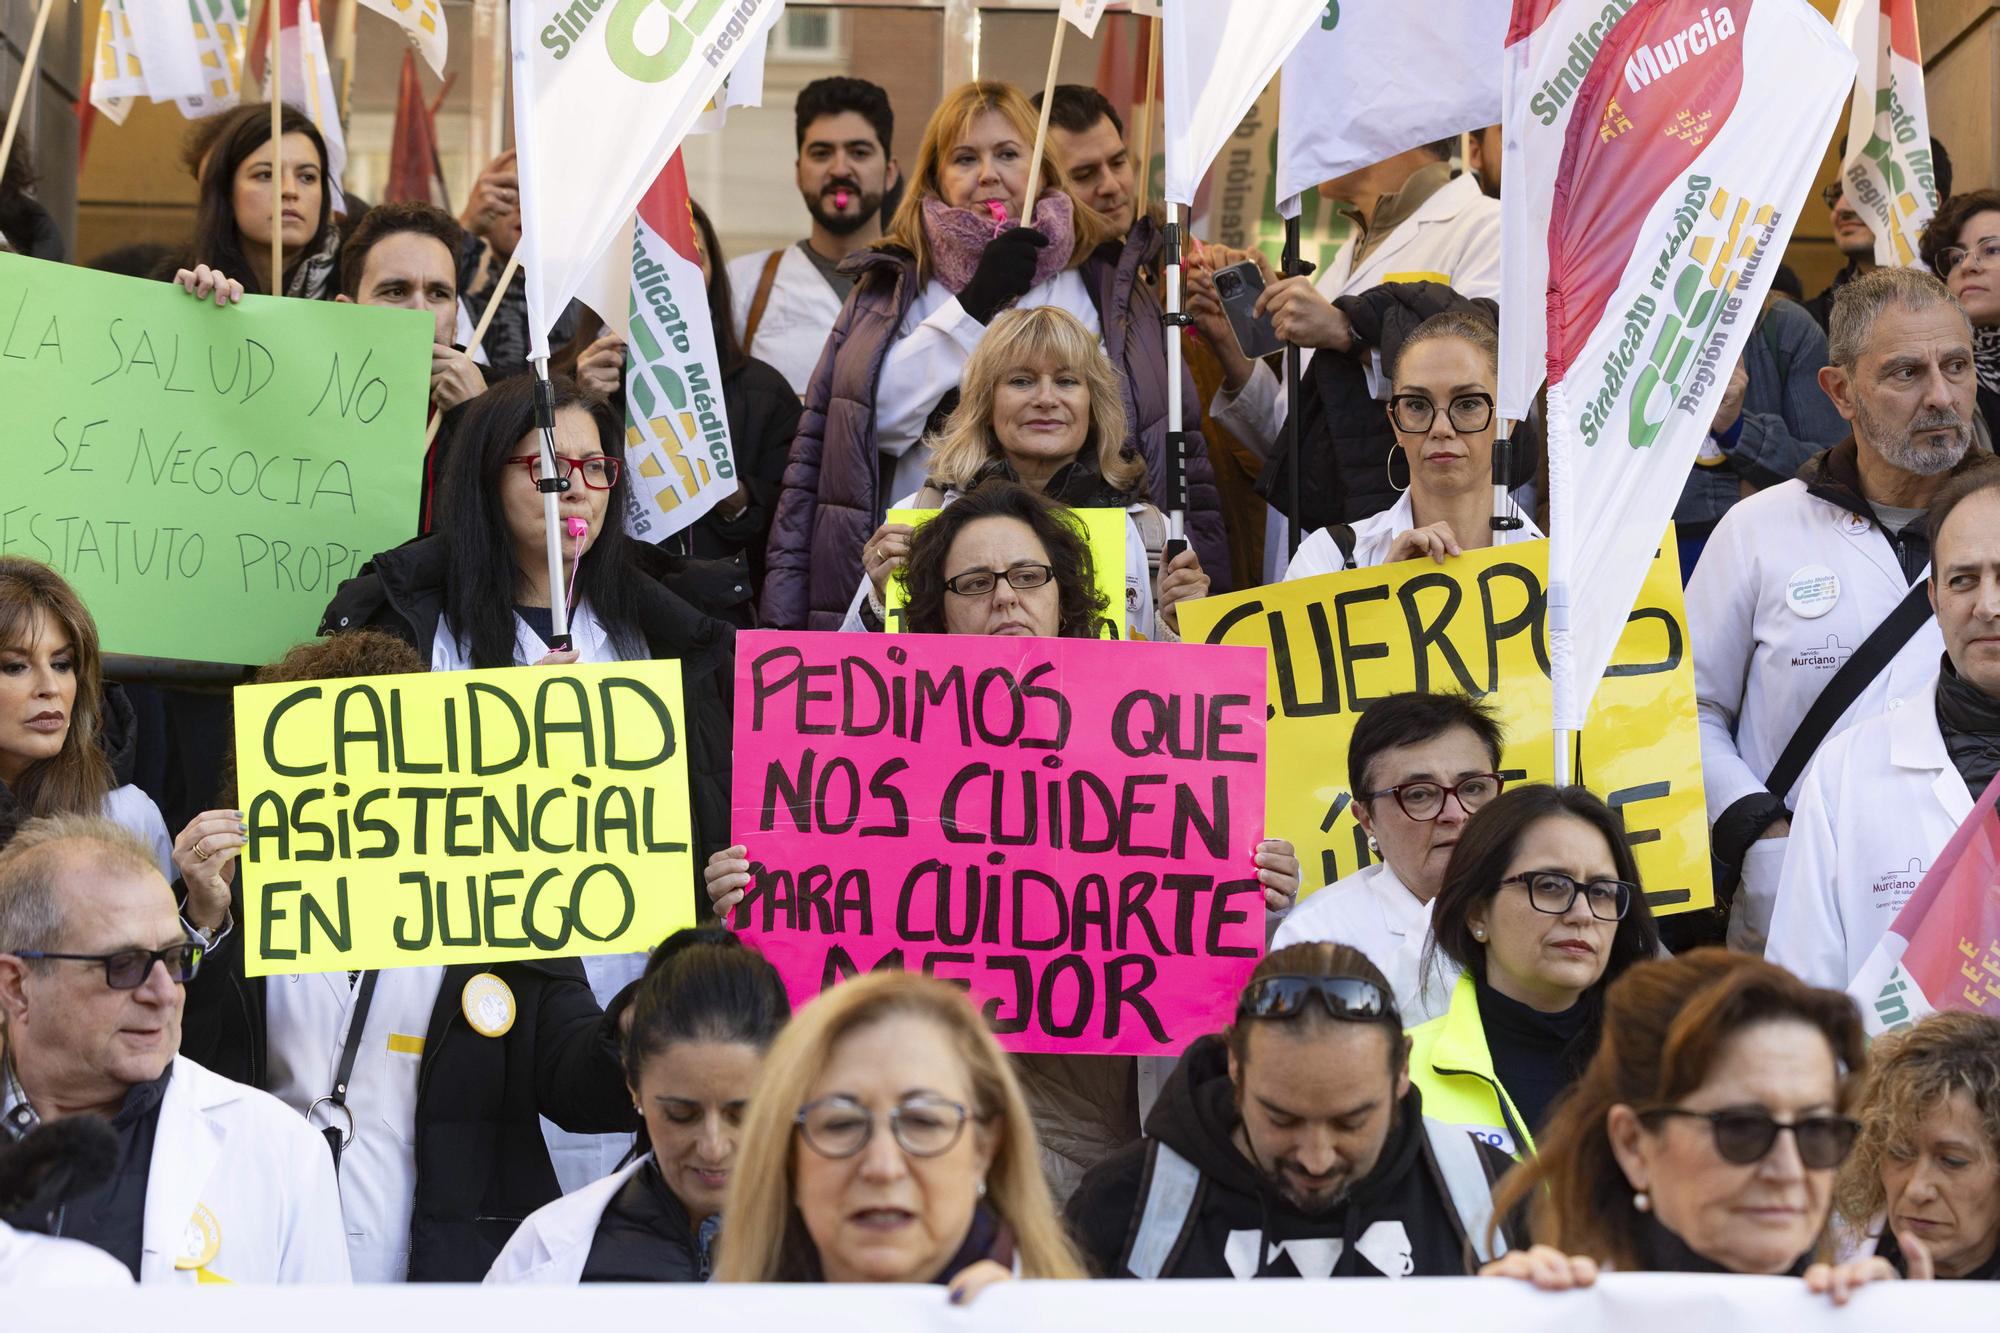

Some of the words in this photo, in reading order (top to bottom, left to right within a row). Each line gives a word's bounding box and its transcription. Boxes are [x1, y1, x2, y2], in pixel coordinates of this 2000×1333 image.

[1624, 6, 1736, 94] Murcia
[3, 288, 63, 364] LA
[91, 318, 275, 404] SALUD
[308, 349, 388, 423] NO
[1677, 333, 1729, 416] Región
[1720, 297, 1743, 326] de
[1735, 212, 1782, 291] Murcia
[1579, 293, 1657, 447] Sindicato
[43, 417, 109, 475] SE
[126, 428, 356, 514] NEGOCIA
[684, 361, 735, 480] Médico
[2, 506, 204, 584] ESTATUTO
[1791, 655, 1836, 667] Murciano
[263, 676, 677, 777] CALIDAD
[1112, 690, 1258, 763] QUE
[760, 749, 910, 838] NOS
[260, 877, 351, 960] EN
[393, 863, 635, 951] JUEGO
[733, 860, 874, 935] PARA
[1872, 879, 1916, 893] Murciano
